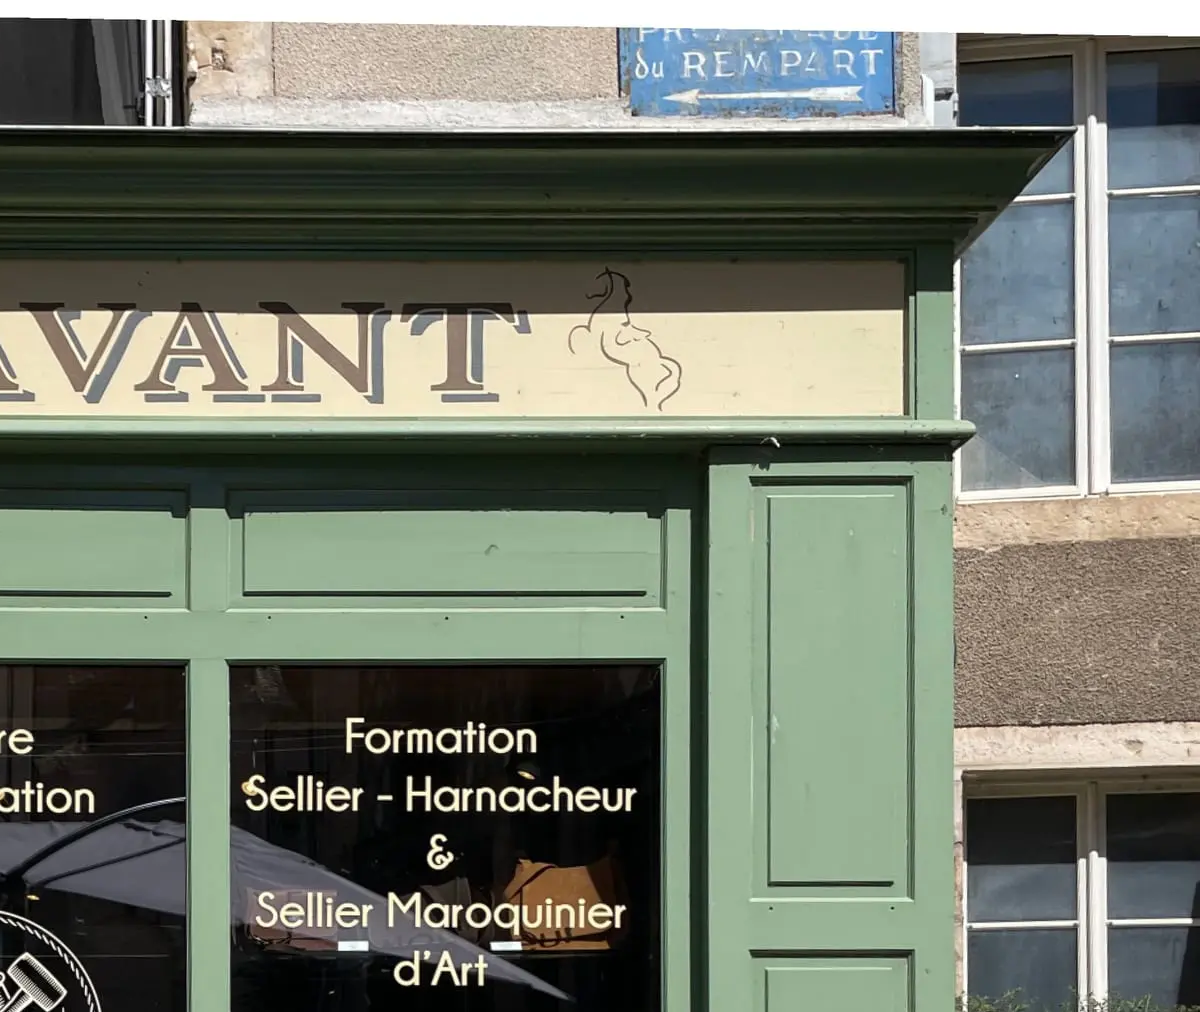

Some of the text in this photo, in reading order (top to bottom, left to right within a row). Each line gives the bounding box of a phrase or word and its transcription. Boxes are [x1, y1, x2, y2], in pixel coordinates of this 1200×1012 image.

[345, 717, 537, 754] Formation
[245, 774, 364, 812] Sellier
[405, 773, 637, 812] Harnacheur
[426, 833, 454, 870] &
[255, 891, 627, 936] Sellier Maroquinier
[394, 951, 489, 987] d'Art
